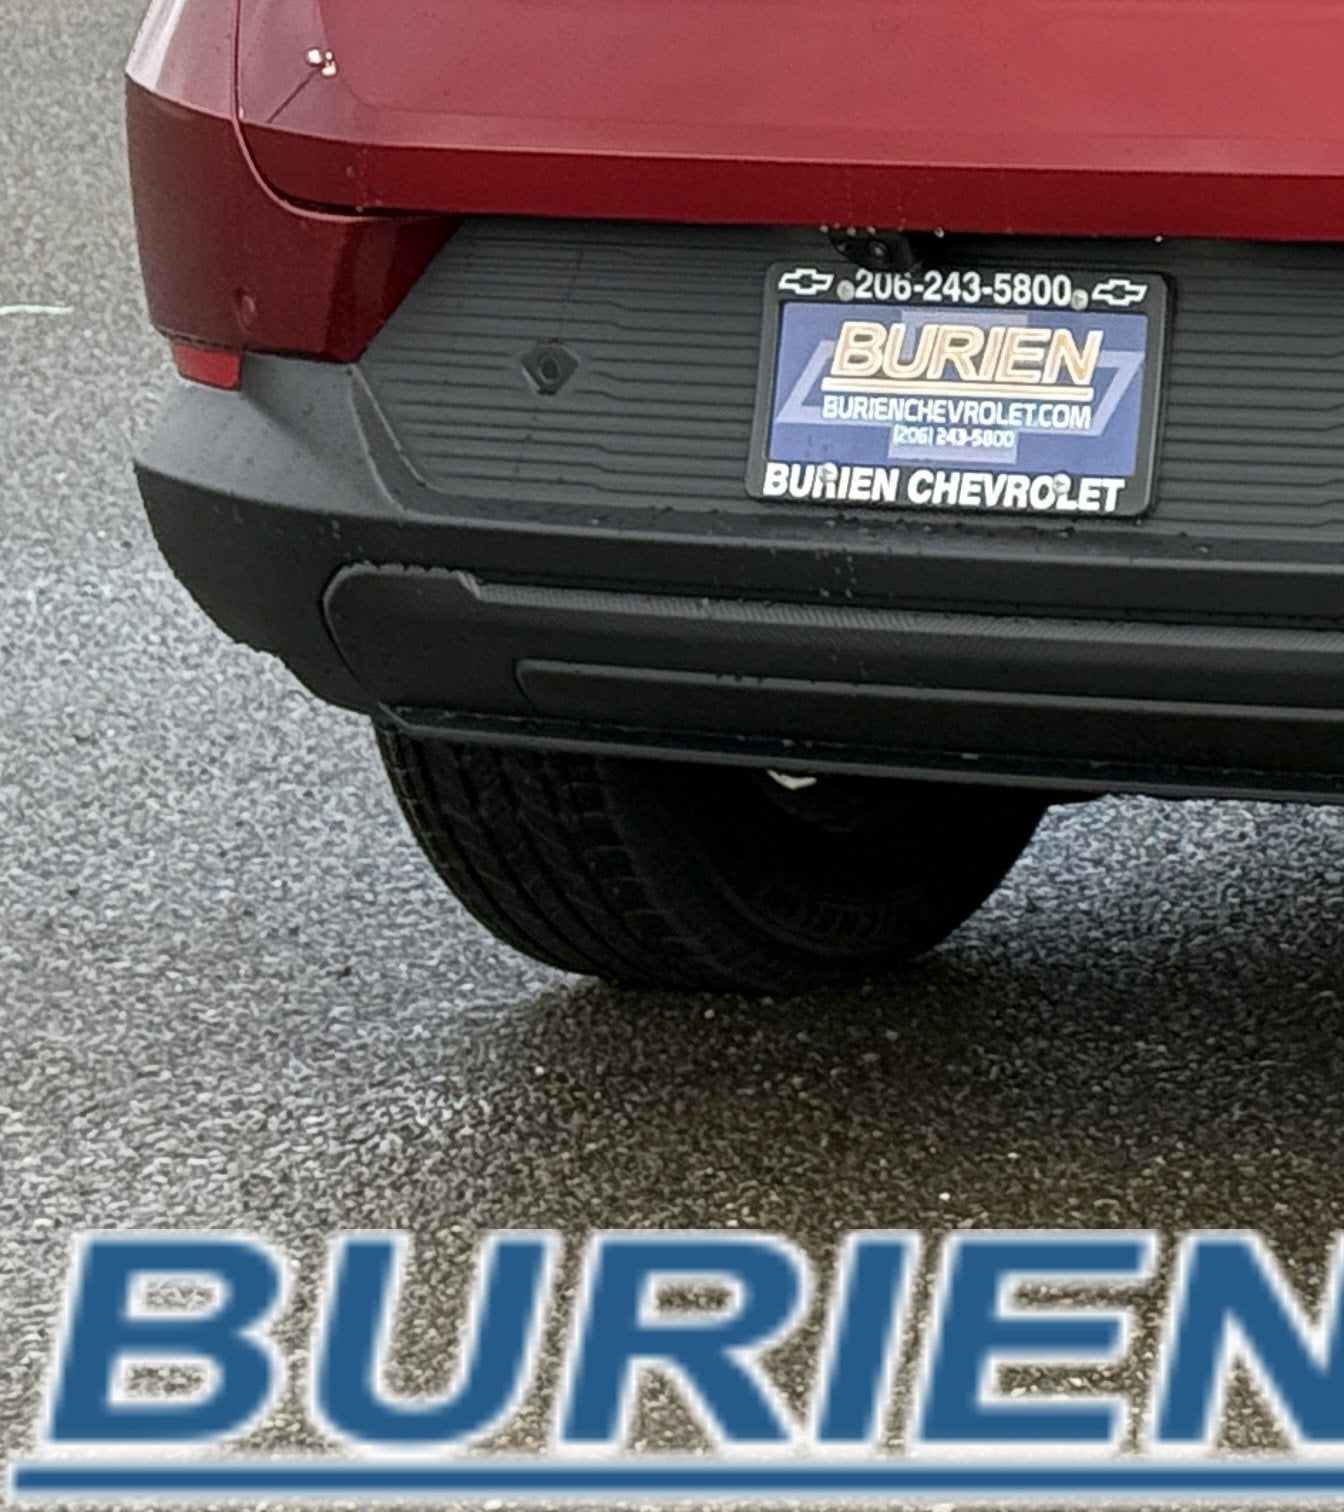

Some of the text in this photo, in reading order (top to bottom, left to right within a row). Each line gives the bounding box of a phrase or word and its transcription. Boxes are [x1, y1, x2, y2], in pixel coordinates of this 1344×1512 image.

[855, 269, 1071, 305] 206-243-5800
[829, 320, 1104, 386] BURIEN
[821, 395, 1092, 429] BURIENCHEVROLET.COM
[763, 461, 1126, 512] BURIEN CHEVROLET
